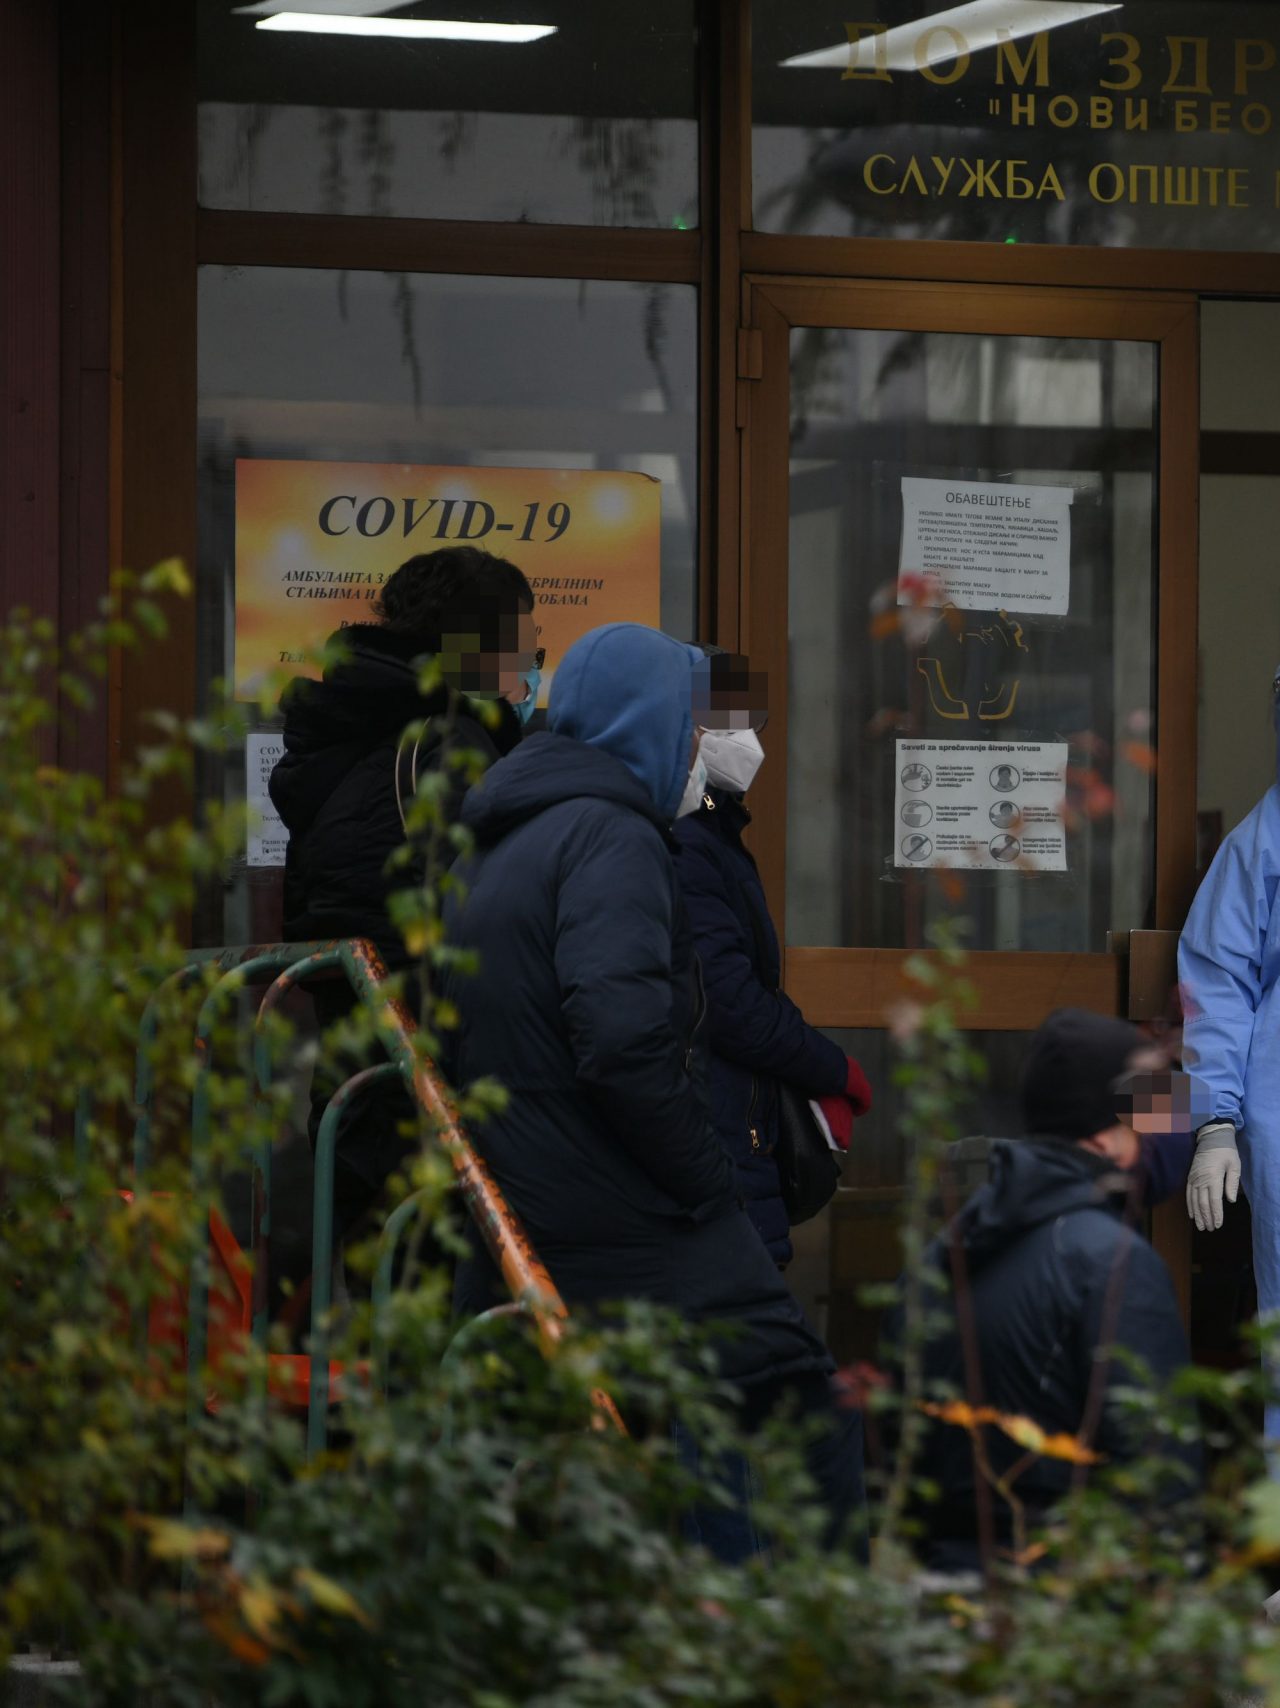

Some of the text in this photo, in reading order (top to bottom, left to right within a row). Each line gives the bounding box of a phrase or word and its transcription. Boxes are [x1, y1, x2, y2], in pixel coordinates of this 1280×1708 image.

[841, 22, 1050, 87] ДОМ
[863, 154, 1066, 201] СЛУЖБА
[1088, 163, 1248, 208] ОПШТЕ
[945, 492, 1031, 509] ОБАВЕШТЕЊЕ
[318, 495, 571, 543] COVID-19
[282, 571, 373, 583] АМБУЛАНТА
[286, 587, 376, 600] СТАЊИМА И
